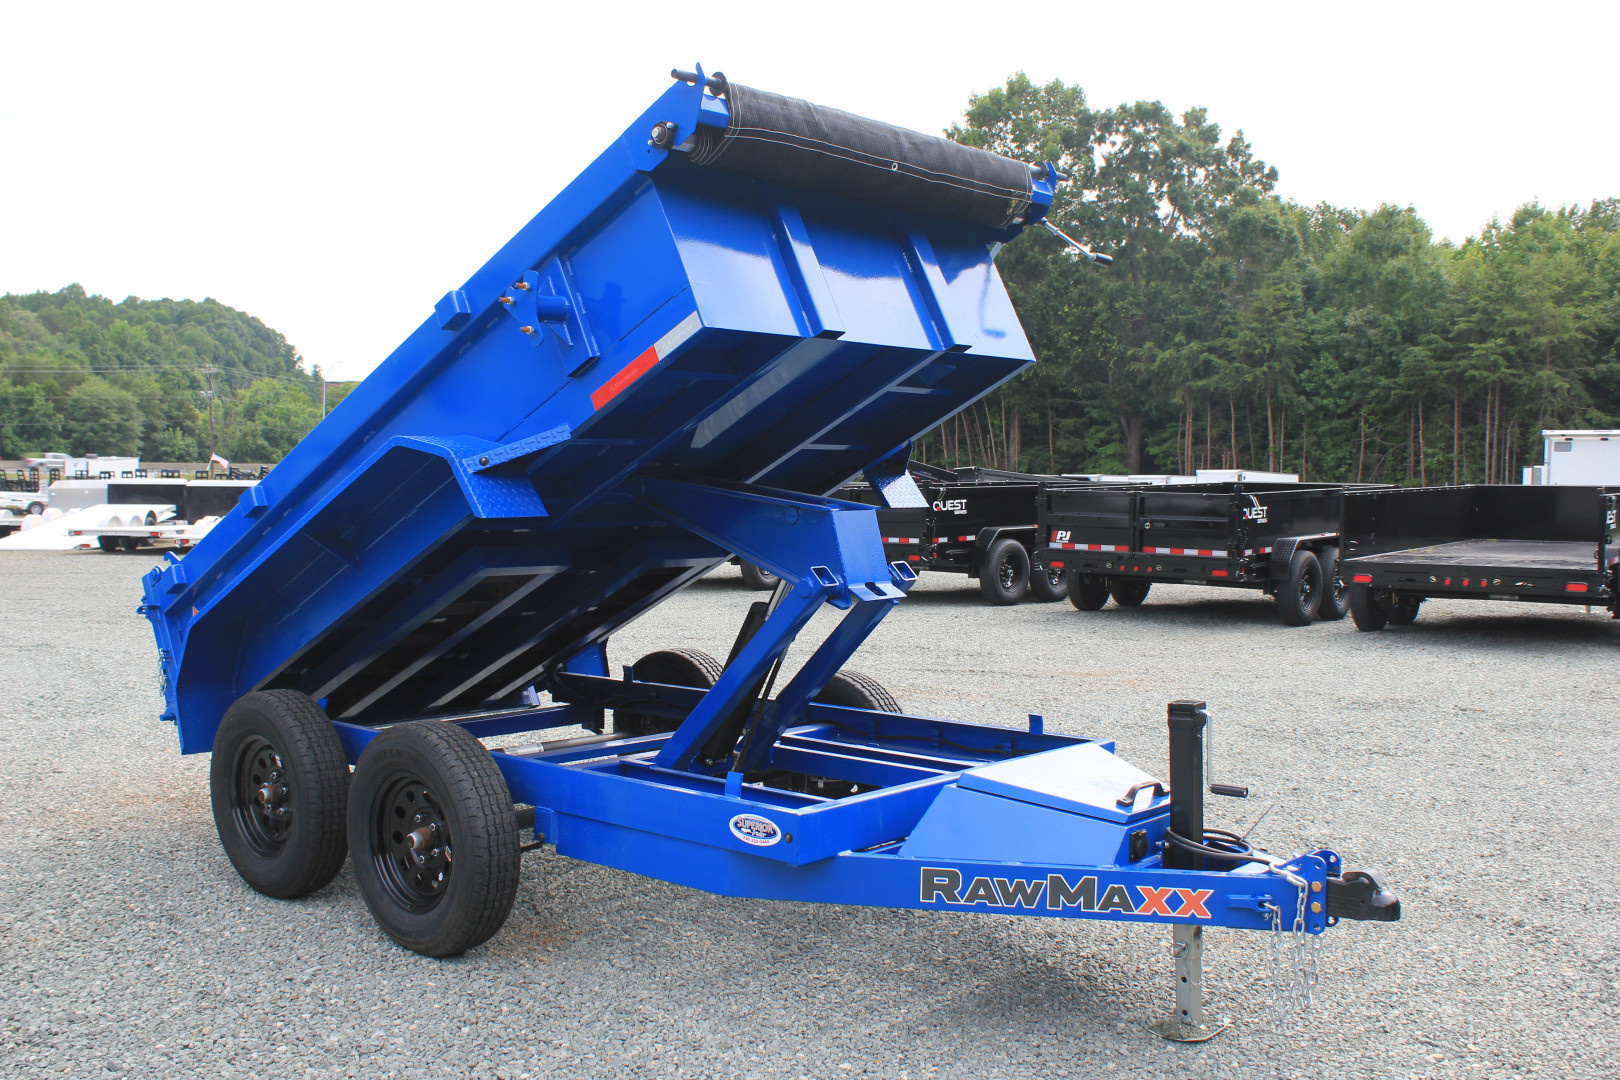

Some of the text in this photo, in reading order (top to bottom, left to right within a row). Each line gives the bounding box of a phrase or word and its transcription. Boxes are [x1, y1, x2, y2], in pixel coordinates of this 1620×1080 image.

[932, 499, 967, 511] QUEST
[1056, 530, 1071, 541] PJ
[736, 816, 775, 835] SUPERIOR
